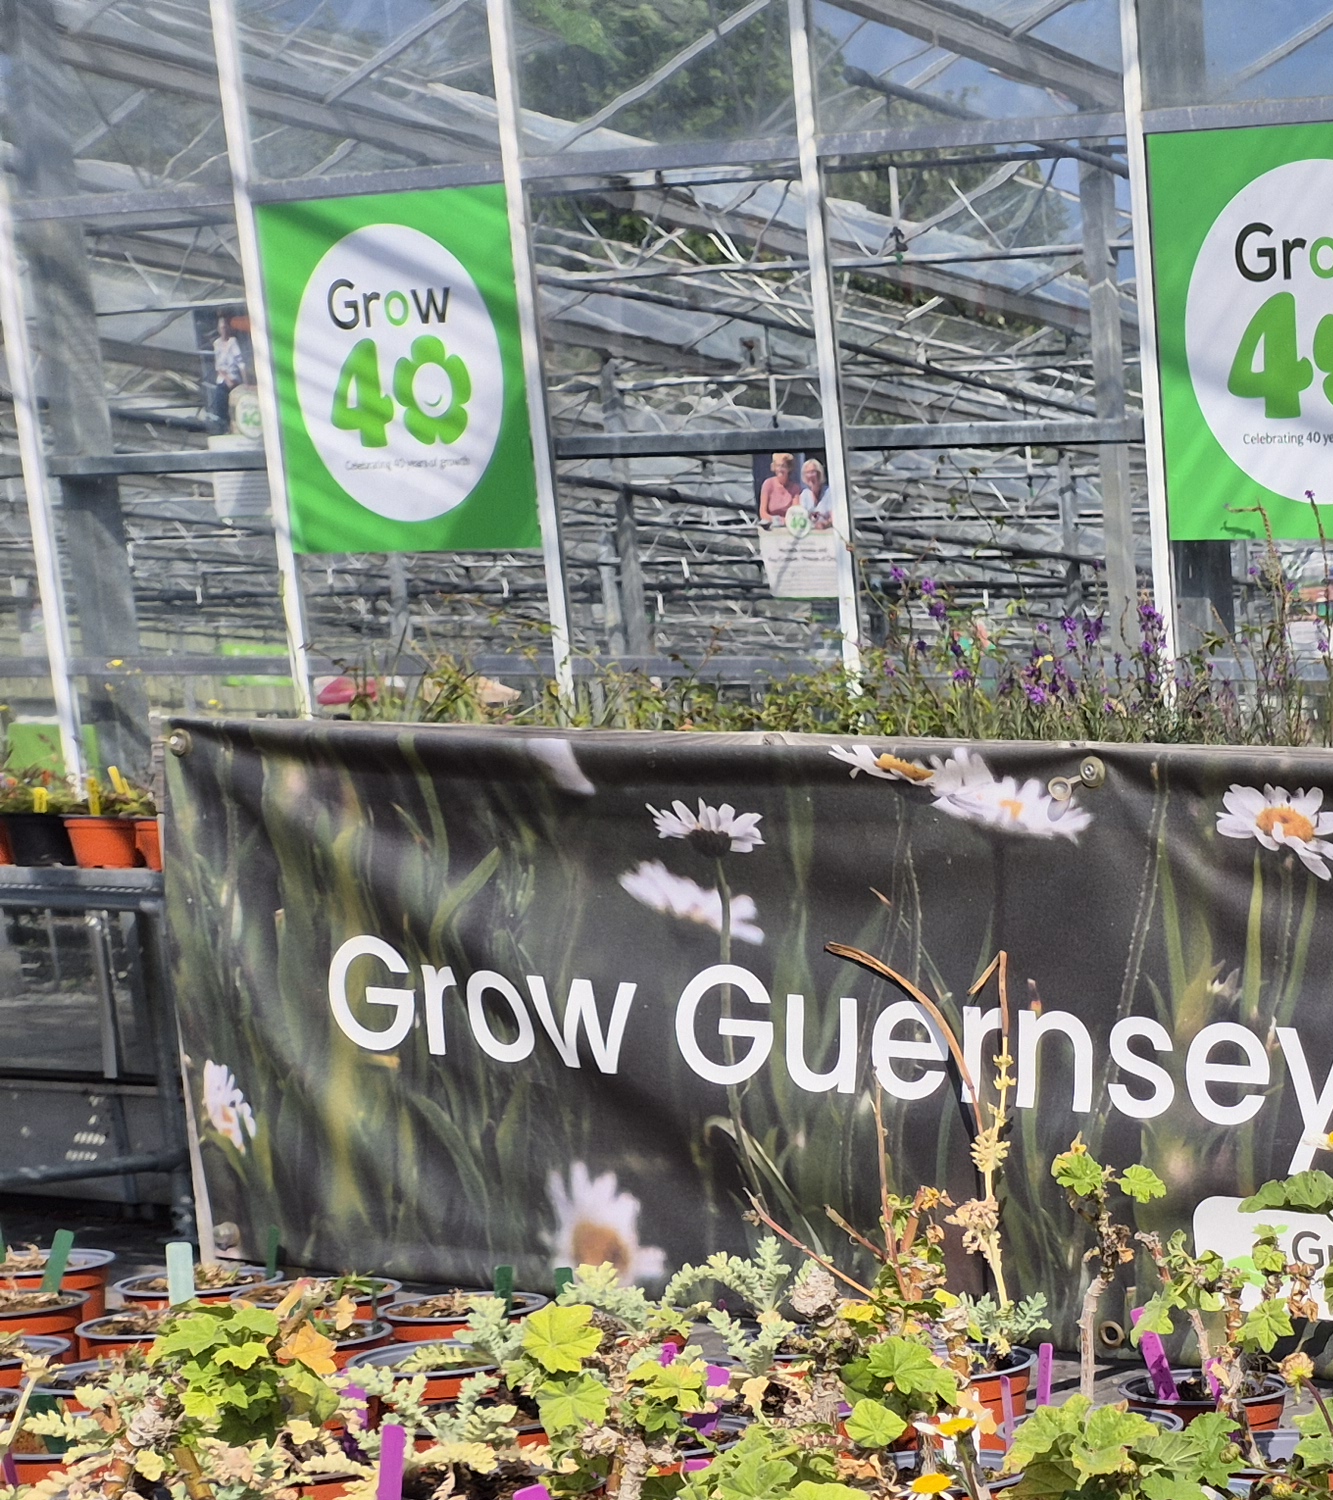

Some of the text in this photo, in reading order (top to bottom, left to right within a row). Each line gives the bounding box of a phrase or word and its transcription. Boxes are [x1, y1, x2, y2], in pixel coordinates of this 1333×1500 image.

[328, 278, 450, 330] Grow
[331, 335, 471, 448] 40
[1243, 433, 1304, 446] Celebrating
[1306, 432, 1321, 444] 40
[328, 935, 636, 1074] Grow
